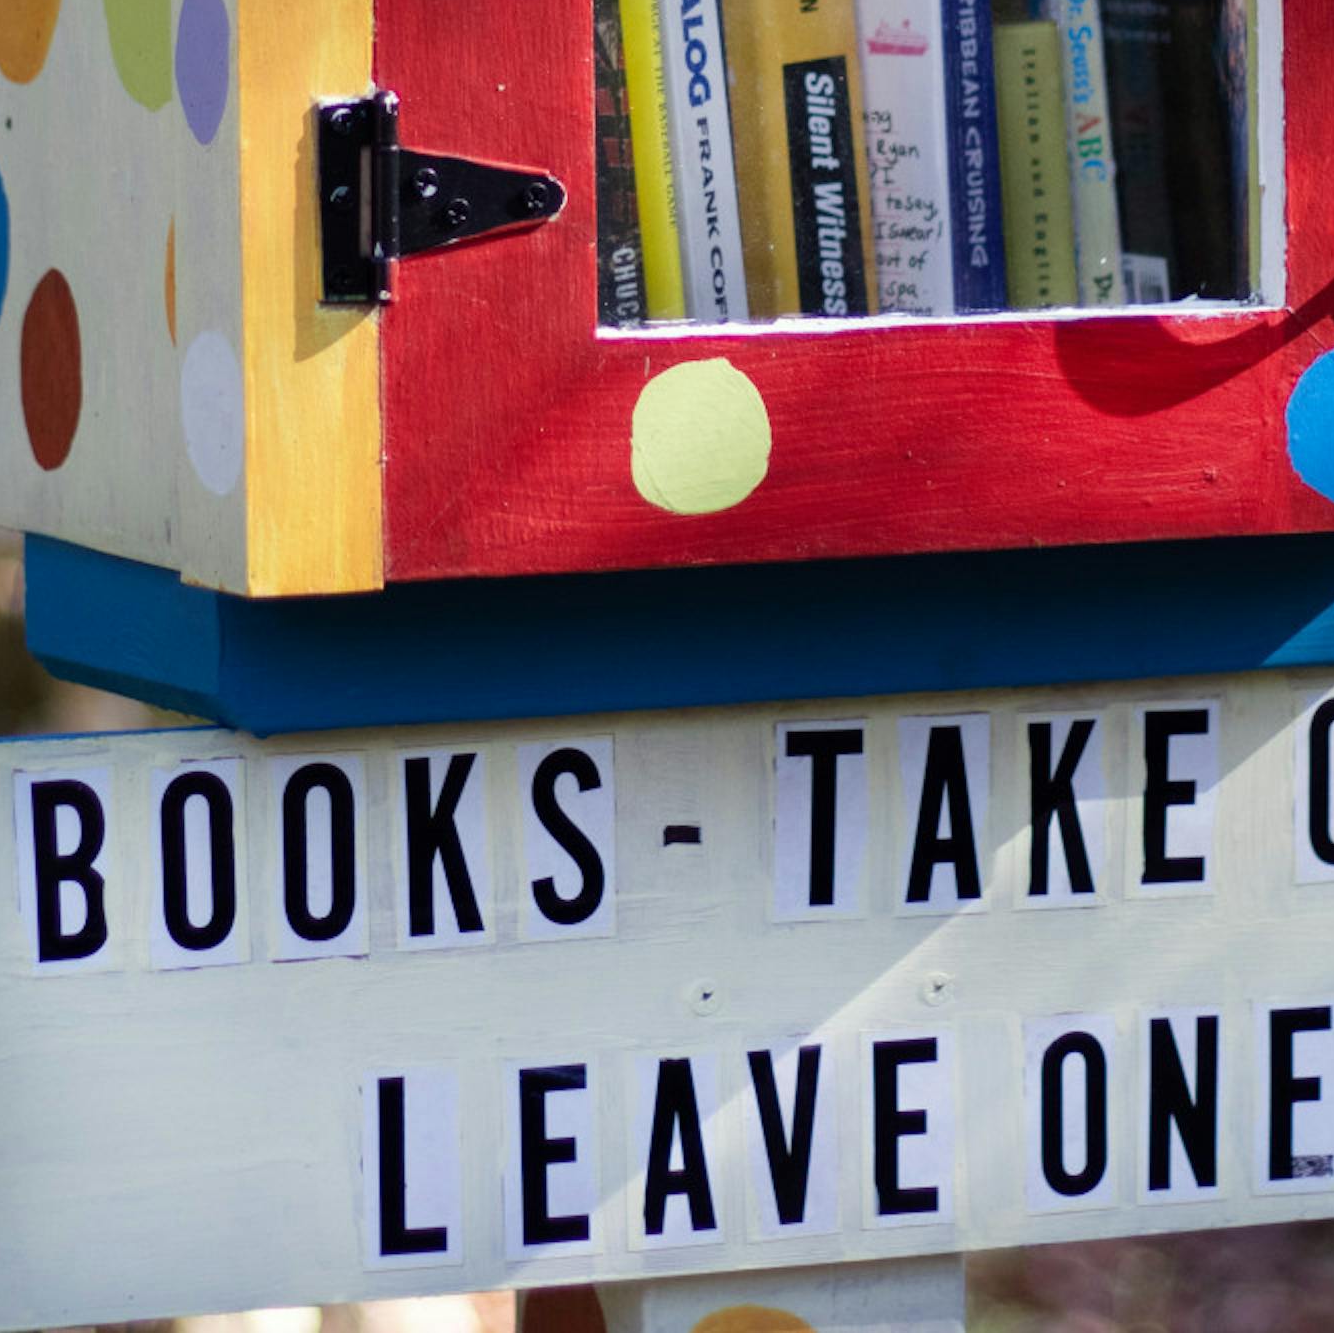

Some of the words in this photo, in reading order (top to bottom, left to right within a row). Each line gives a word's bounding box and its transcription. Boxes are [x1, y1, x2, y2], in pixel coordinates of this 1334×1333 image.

[803, 69, 841, 172] Silent
[1068, 25, 1095, 105] Seuss's
[965, 125, 988, 268] CRUISING
[1075, 113, 1108, 183] ABC
[696, 116, 721, 240] FRANK
[709, 245, 729, 322] COF
[812, 181, 848, 315] Witness
[1033, 214, 1049, 303] Englis
[30, 745, 607, 963] BOOKS
[662, 824, 703, 846] -
[784, 709, 1208, 909] TAKE
[377, 1036, 942, 1256] LEAVE
